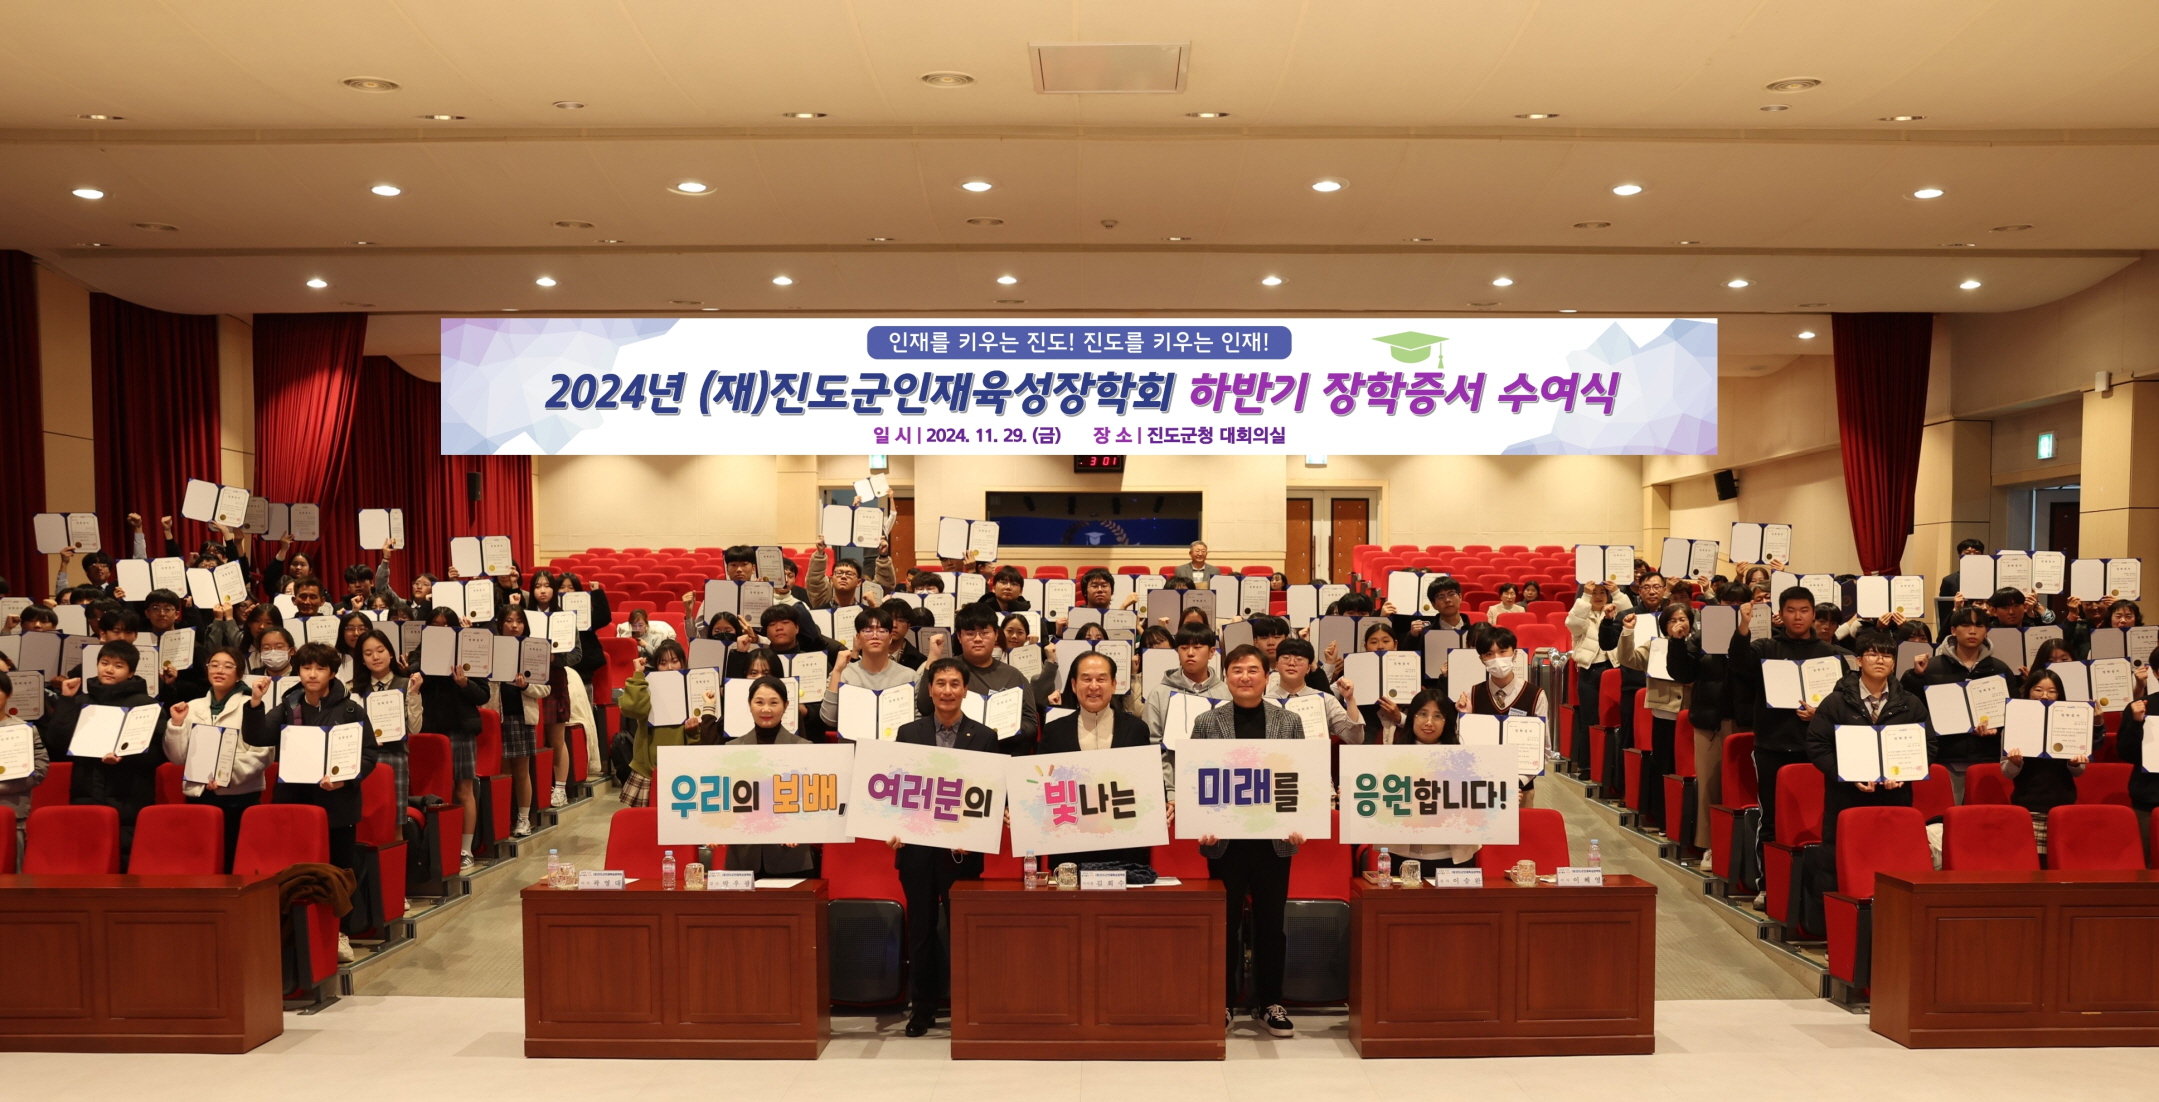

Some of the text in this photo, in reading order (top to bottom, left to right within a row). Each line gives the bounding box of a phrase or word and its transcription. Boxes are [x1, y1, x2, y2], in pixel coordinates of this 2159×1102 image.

[890, 331, 1269, 354] 인재를 키우는 진도! 진도를 키우는 인재!
[545, 370, 1621, 416] 2024년 (재)진도군인재육성장학회 하반기 장학증서 수여식
[926, 427, 970, 443] 2024.
[976, 427, 998, 443] 11.
[1003, 427, 1027, 443] 29.
[1032, 426, 1062, 445] (금)
[1147, 426, 1214, 445] 진도군청
[1220, 426, 1286, 445] 대회의실
[671, 773, 847, 819] 우리의 보배,
[867, 772, 993, 822] 여러분의
[1044, 778, 1137, 827] 빛나는
[1197, 767, 1299, 813] 미래를
[1353, 773, 1507, 818] 응원합니다!
